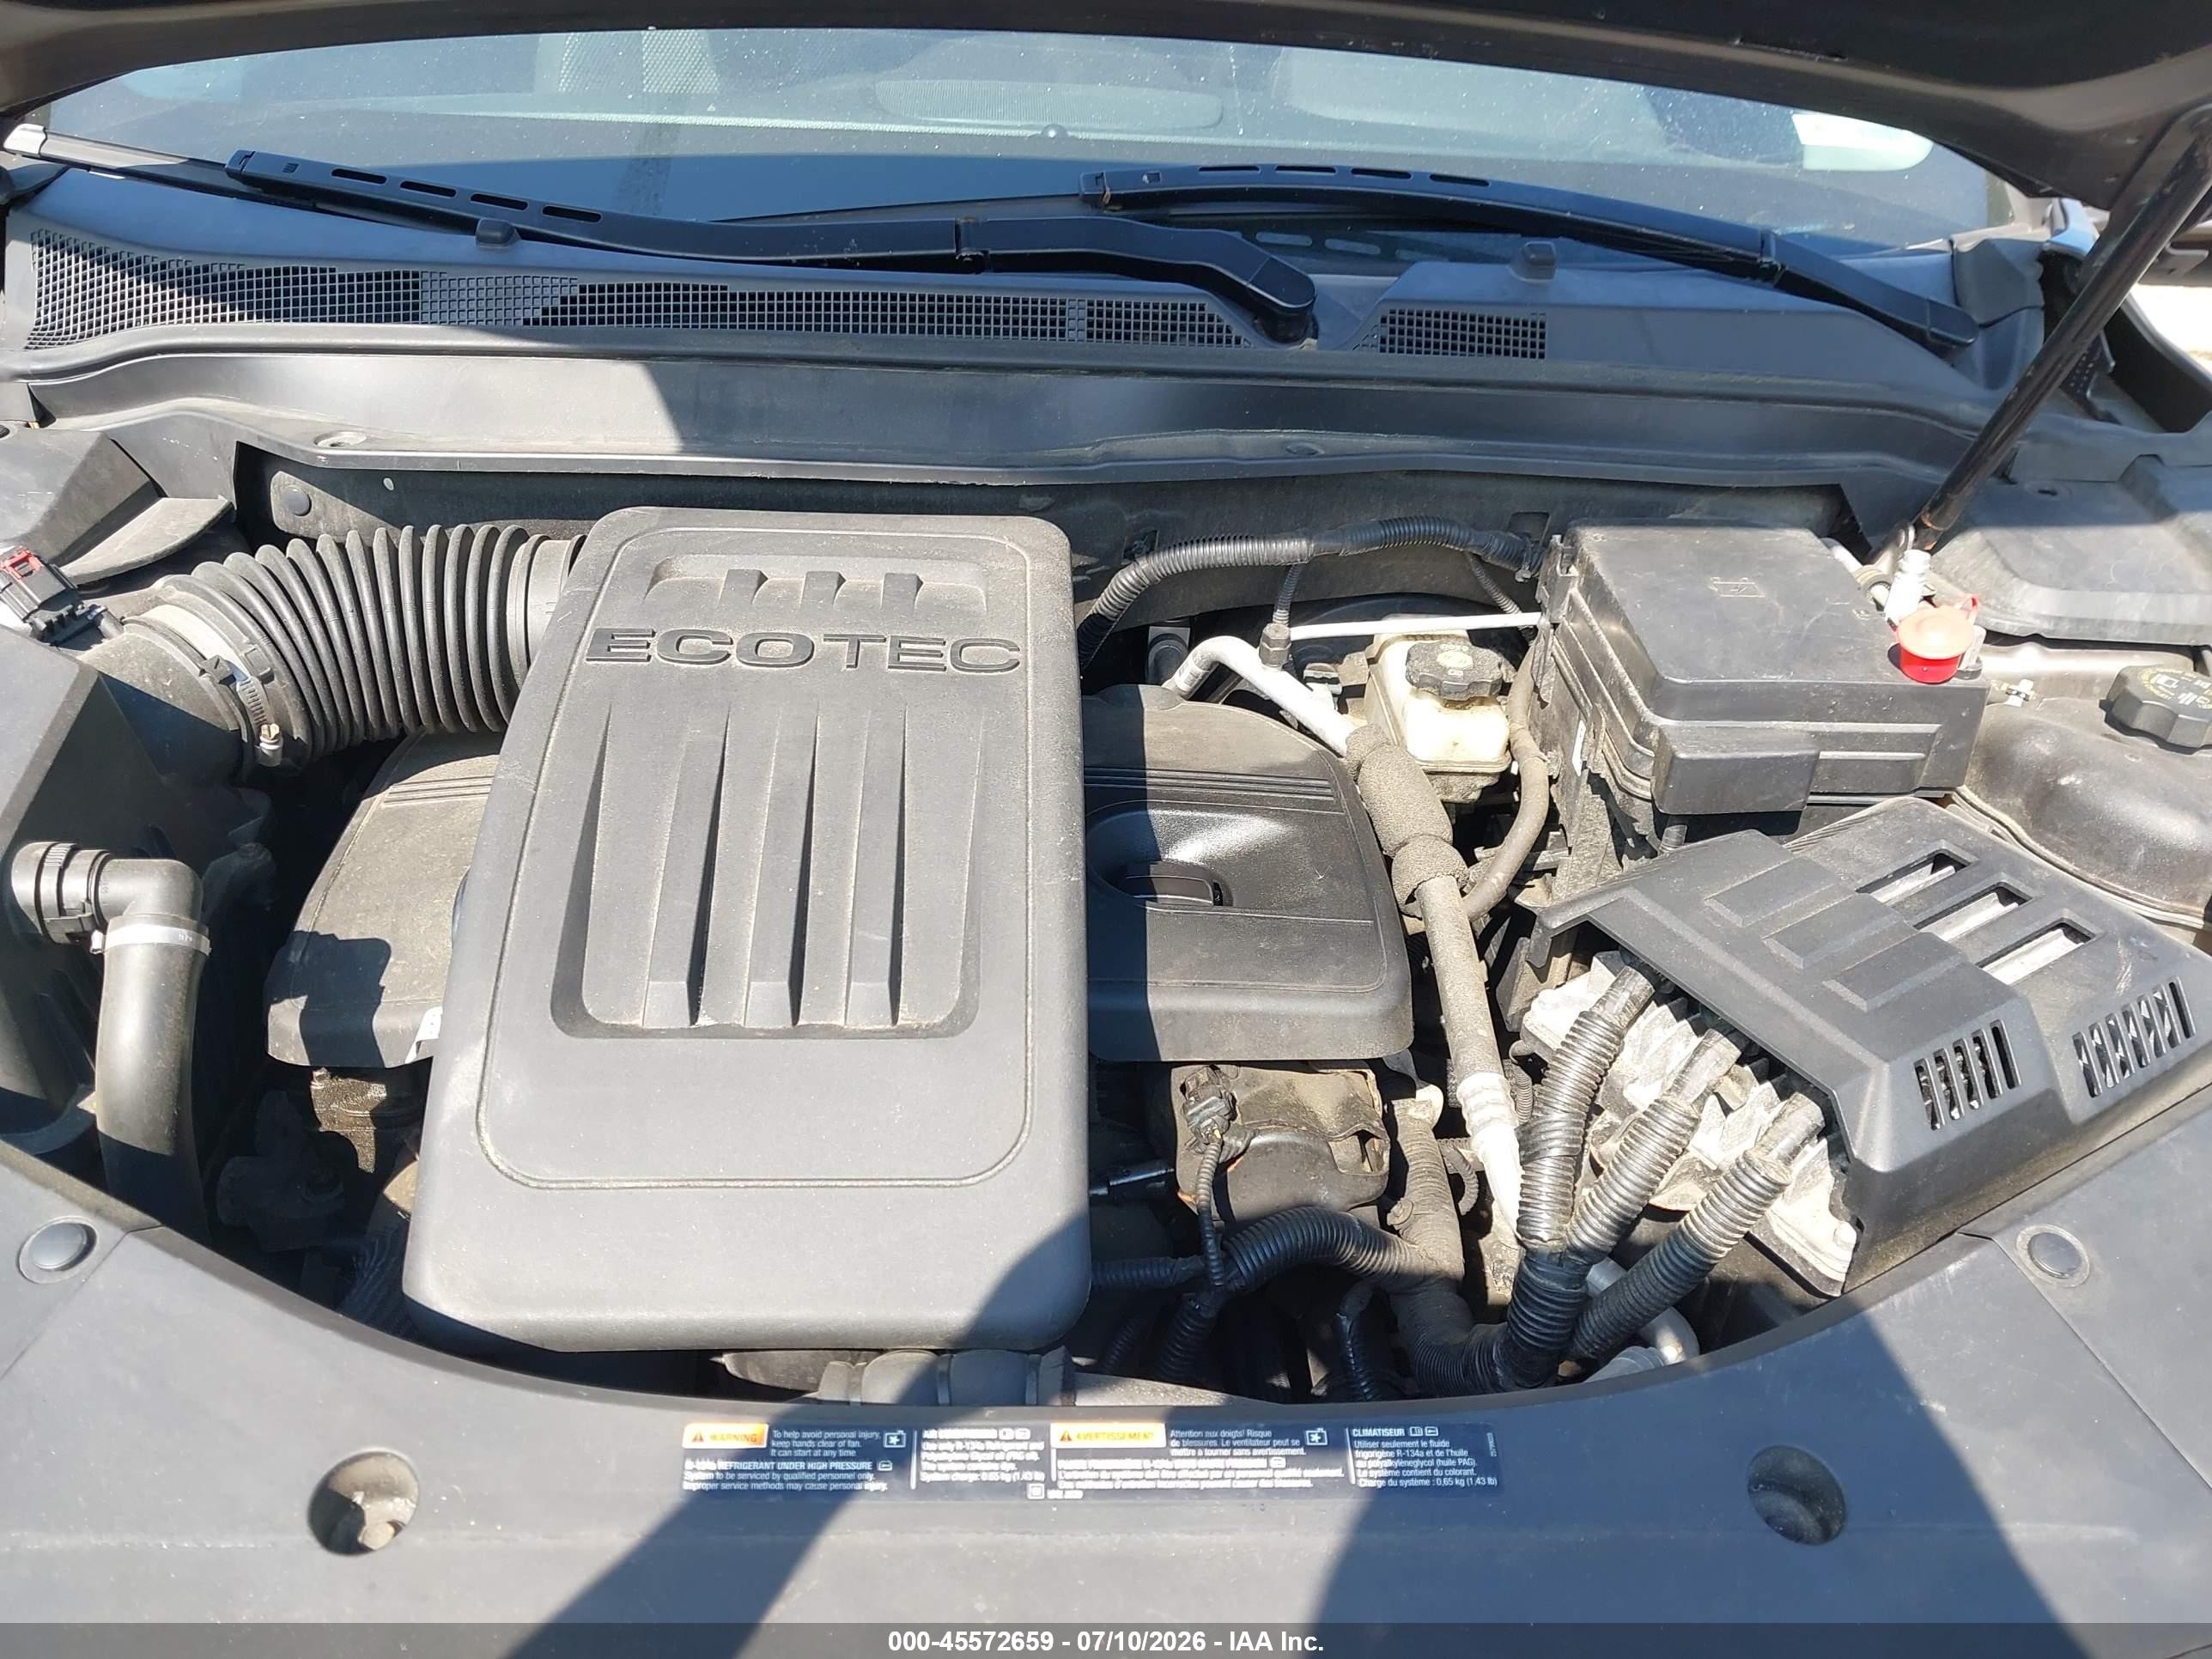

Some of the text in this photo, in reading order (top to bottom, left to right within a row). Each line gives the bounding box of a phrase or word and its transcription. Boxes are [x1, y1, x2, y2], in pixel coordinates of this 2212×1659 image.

[585, 627, 1021, 675] ECOTEC
[711, 1432, 757, 1443] WARNING
[783, 1430, 799, 1440] help
[824, 1431, 856, 1440] personal
[858, 1431, 881, 1440] injury,
[1077, 1431, 1154, 1440] AVERTISSEMENT
[1170, 1430, 1203, 1438] Attention
[1219, 1430, 1245, 1439] doigts!
[1247, 1430, 1273, 1439] Risque
[1352, 1428, 1406, 1437] CLIMATISEUR
[772, 1440, 791, 1449] keep
[1170, 1439, 1181, 1448] de
[1221, 1439, 1231, 1448] Le
[1232, 1438, 1271, 1448] ventilateur
[1273, 1438, 1290, 1448] peut
[1381, 1440, 1419, 1449] seulement
[1420, 1440, 1428, 1449] le
[1429, 1439, 1450, 1449] fluide
[1396, 1449, 1425, 1458] R-134a
[1446, 1448, 1469, 1457] l'huile
[717, 1460, 776, 1470] REFRIGERANT
[777, 1461, 805, 1470] UNDER
[807, 1461, 828, 1470] HIGH
[830, 1461, 872, 1470] PRESSURE
[1436, 1458, 1456, 1468] (huile
[715, 1472, 724, 1480] to
[726, 1472, 736, 1480] be
[738, 1472, 769, 1480] serviced
[772, 1472, 781, 1481] by
[783, 1472, 817, 1481] qualified
[817, 1472, 855, 1481] personnel
[1369, 1468, 1401, 1479] système
[1401, 1468, 1431, 1477] contient
[1433, 1468, 1443, 1476] du
[1444, 1468, 1477, 1476] colorant.
[720, 1482, 750, 1491] service
[751, 1482, 784, 1491] methods
[786, 1483, 802, 1492] may
[830, 1482, 862, 1492] personal
[1358, 1478, 1387, 1488] Charge
[1388, 1478, 1399, 1486] du
[1399, 1478, 1431, 1488] système
[1436, 1477, 1454, 1486] 0,65
[1455, 1477, 1465, 1487] kg
[1487, 1476, 1498, 1486] lb)
